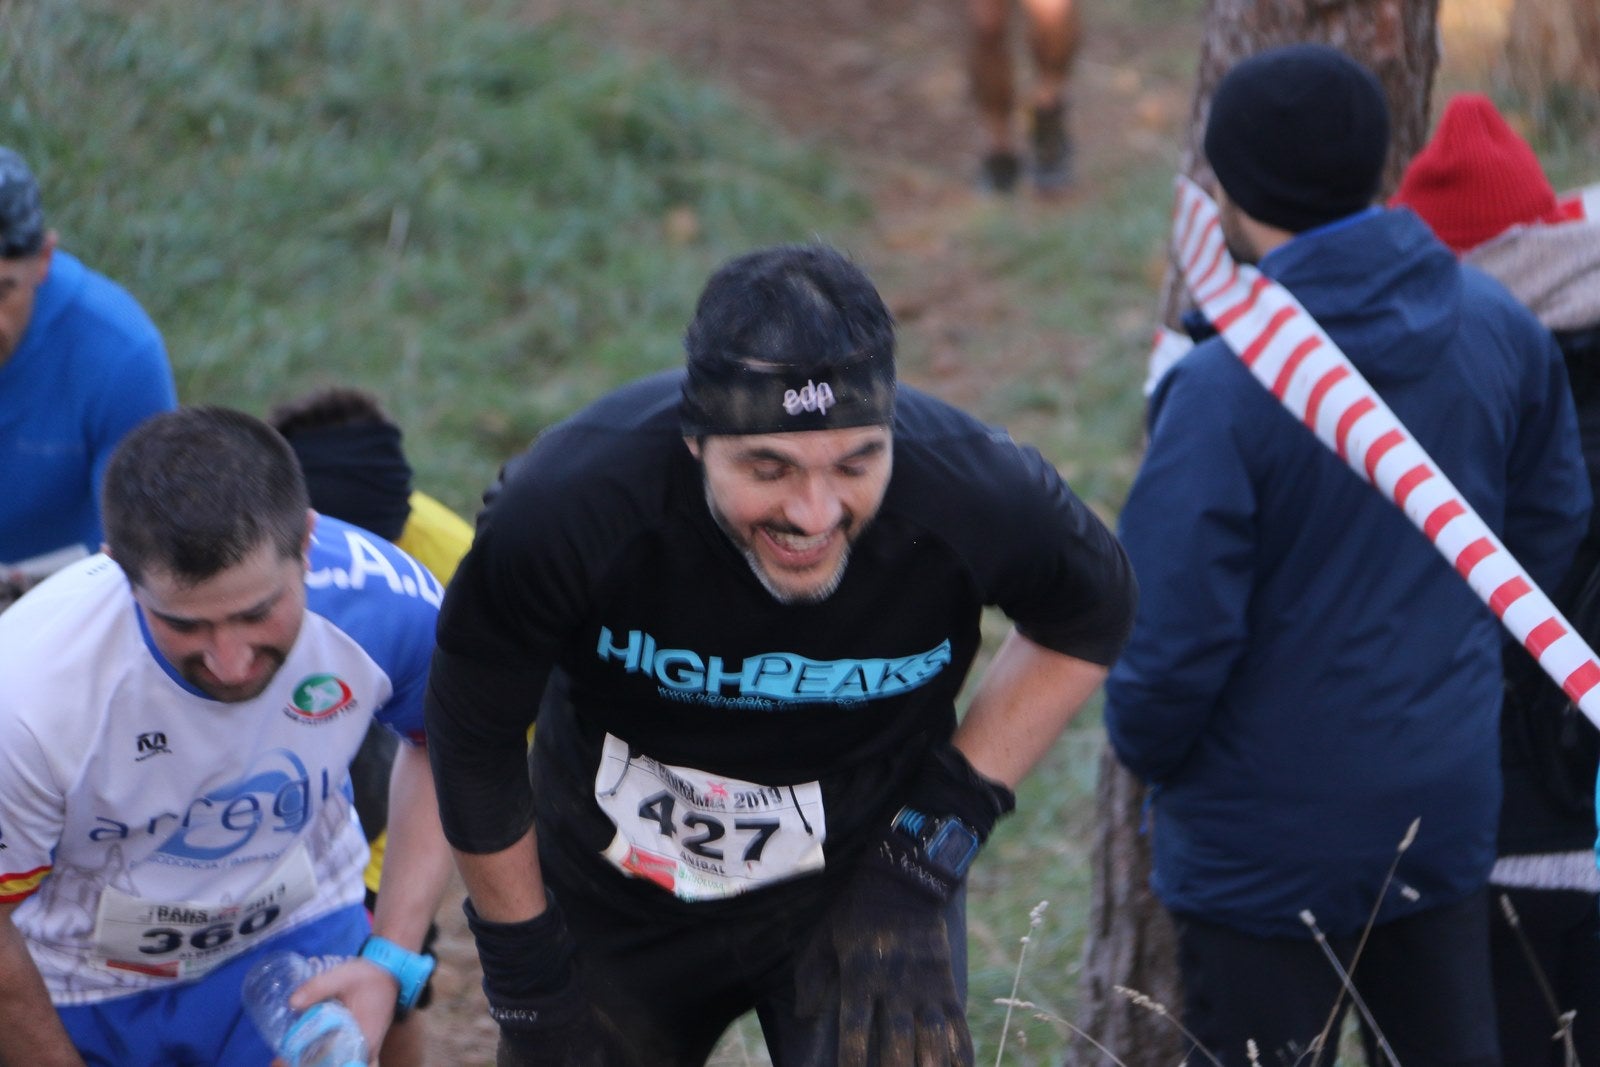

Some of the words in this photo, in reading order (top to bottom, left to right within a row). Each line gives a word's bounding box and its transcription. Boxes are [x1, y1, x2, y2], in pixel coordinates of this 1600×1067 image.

[782, 379, 836, 416] edp
[638, 789, 780, 861] 427
[138, 905, 281, 955] 360
